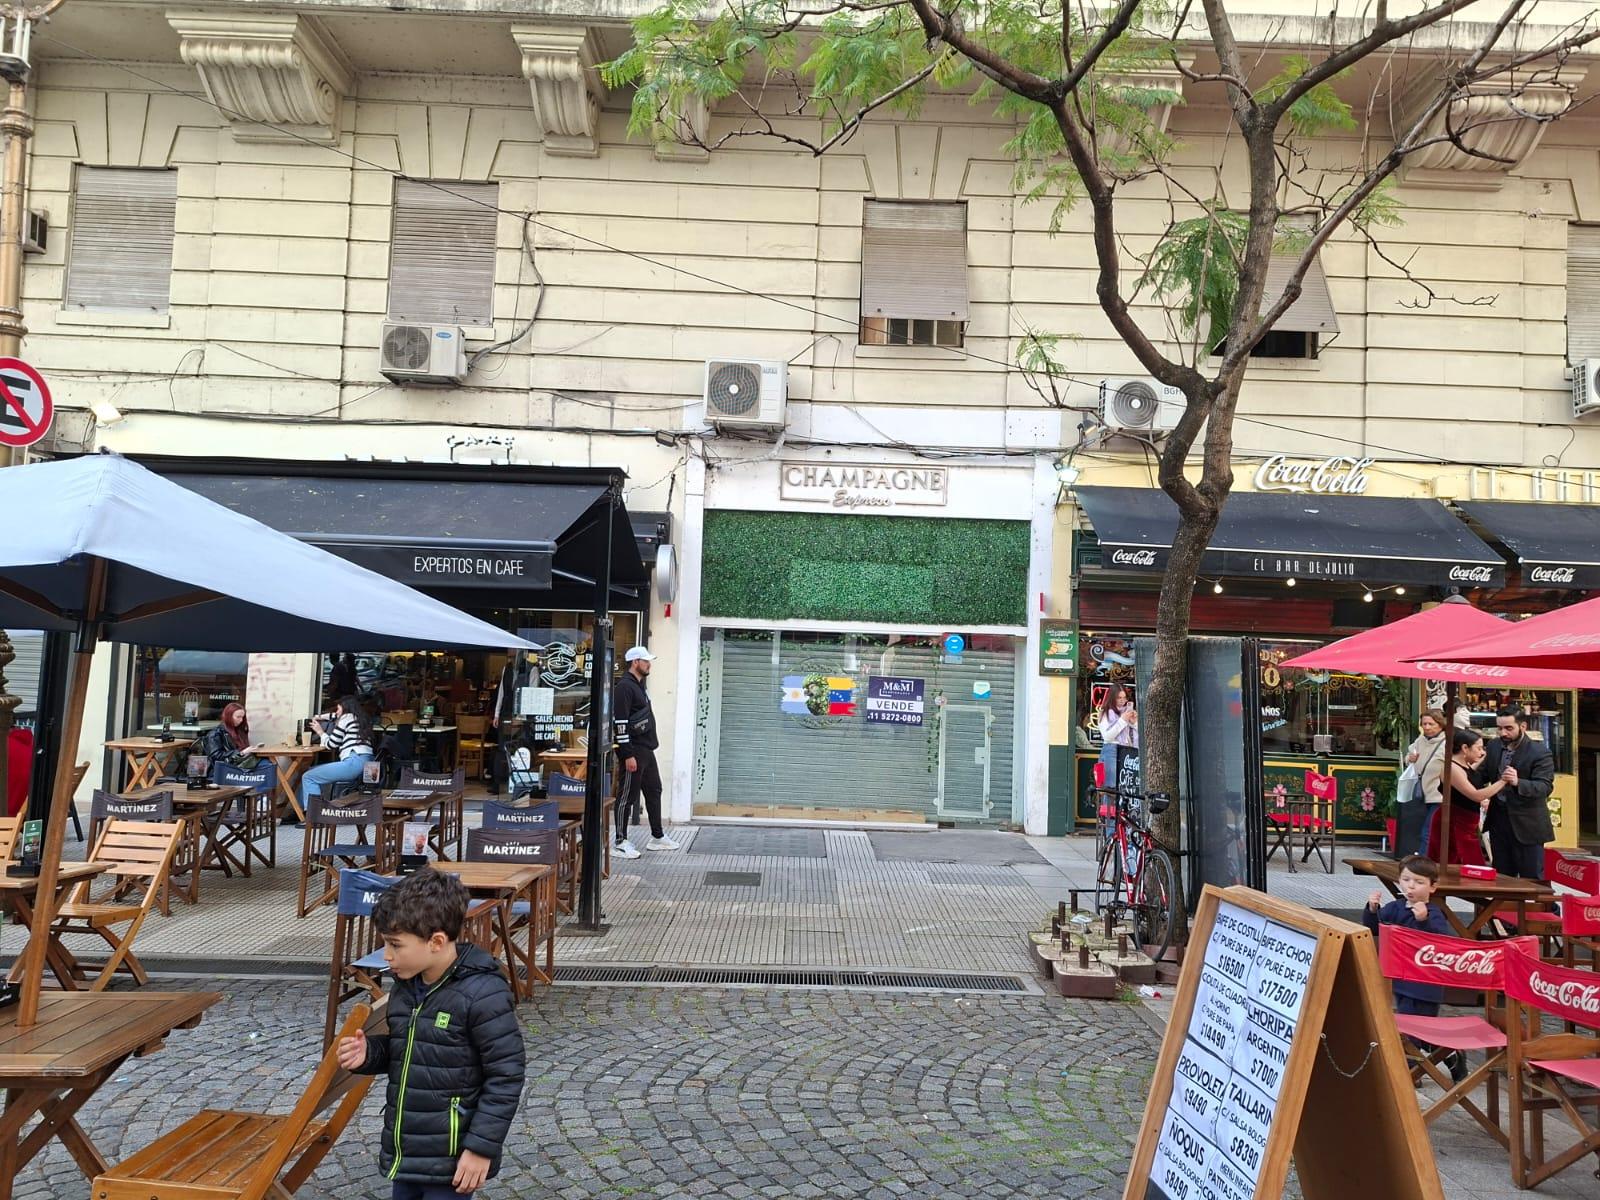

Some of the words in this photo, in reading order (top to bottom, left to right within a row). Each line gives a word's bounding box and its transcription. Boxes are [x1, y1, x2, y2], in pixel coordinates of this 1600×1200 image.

[785, 467, 943, 491] CHAMPAGNE
[414, 556, 473, 574] EXPERTOS
[476, 558, 492, 574] EN
[1254, 558, 1265, 571] EL
[1276, 560, 1299, 572] BAR
[1309, 561, 1321, 574] DE
[1325, 561, 1354, 575] JULIO
[876, 700, 915, 711] VENDE
[561, 783, 586, 792] MARTI
[1260, 935, 1277, 951] BIFE
[1275, 941, 1287, 955] DE
[1286, 945, 1312, 966] CHOR
[1284, 967, 1297, 982] DE
[1259, 979, 1298, 1008] $17500
[1251, 1058, 1279, 1089] $7000
[1169, 1116, 1205, 1167] ÑOQUIS
[1230, 1135, 1259, 1171] $8390
